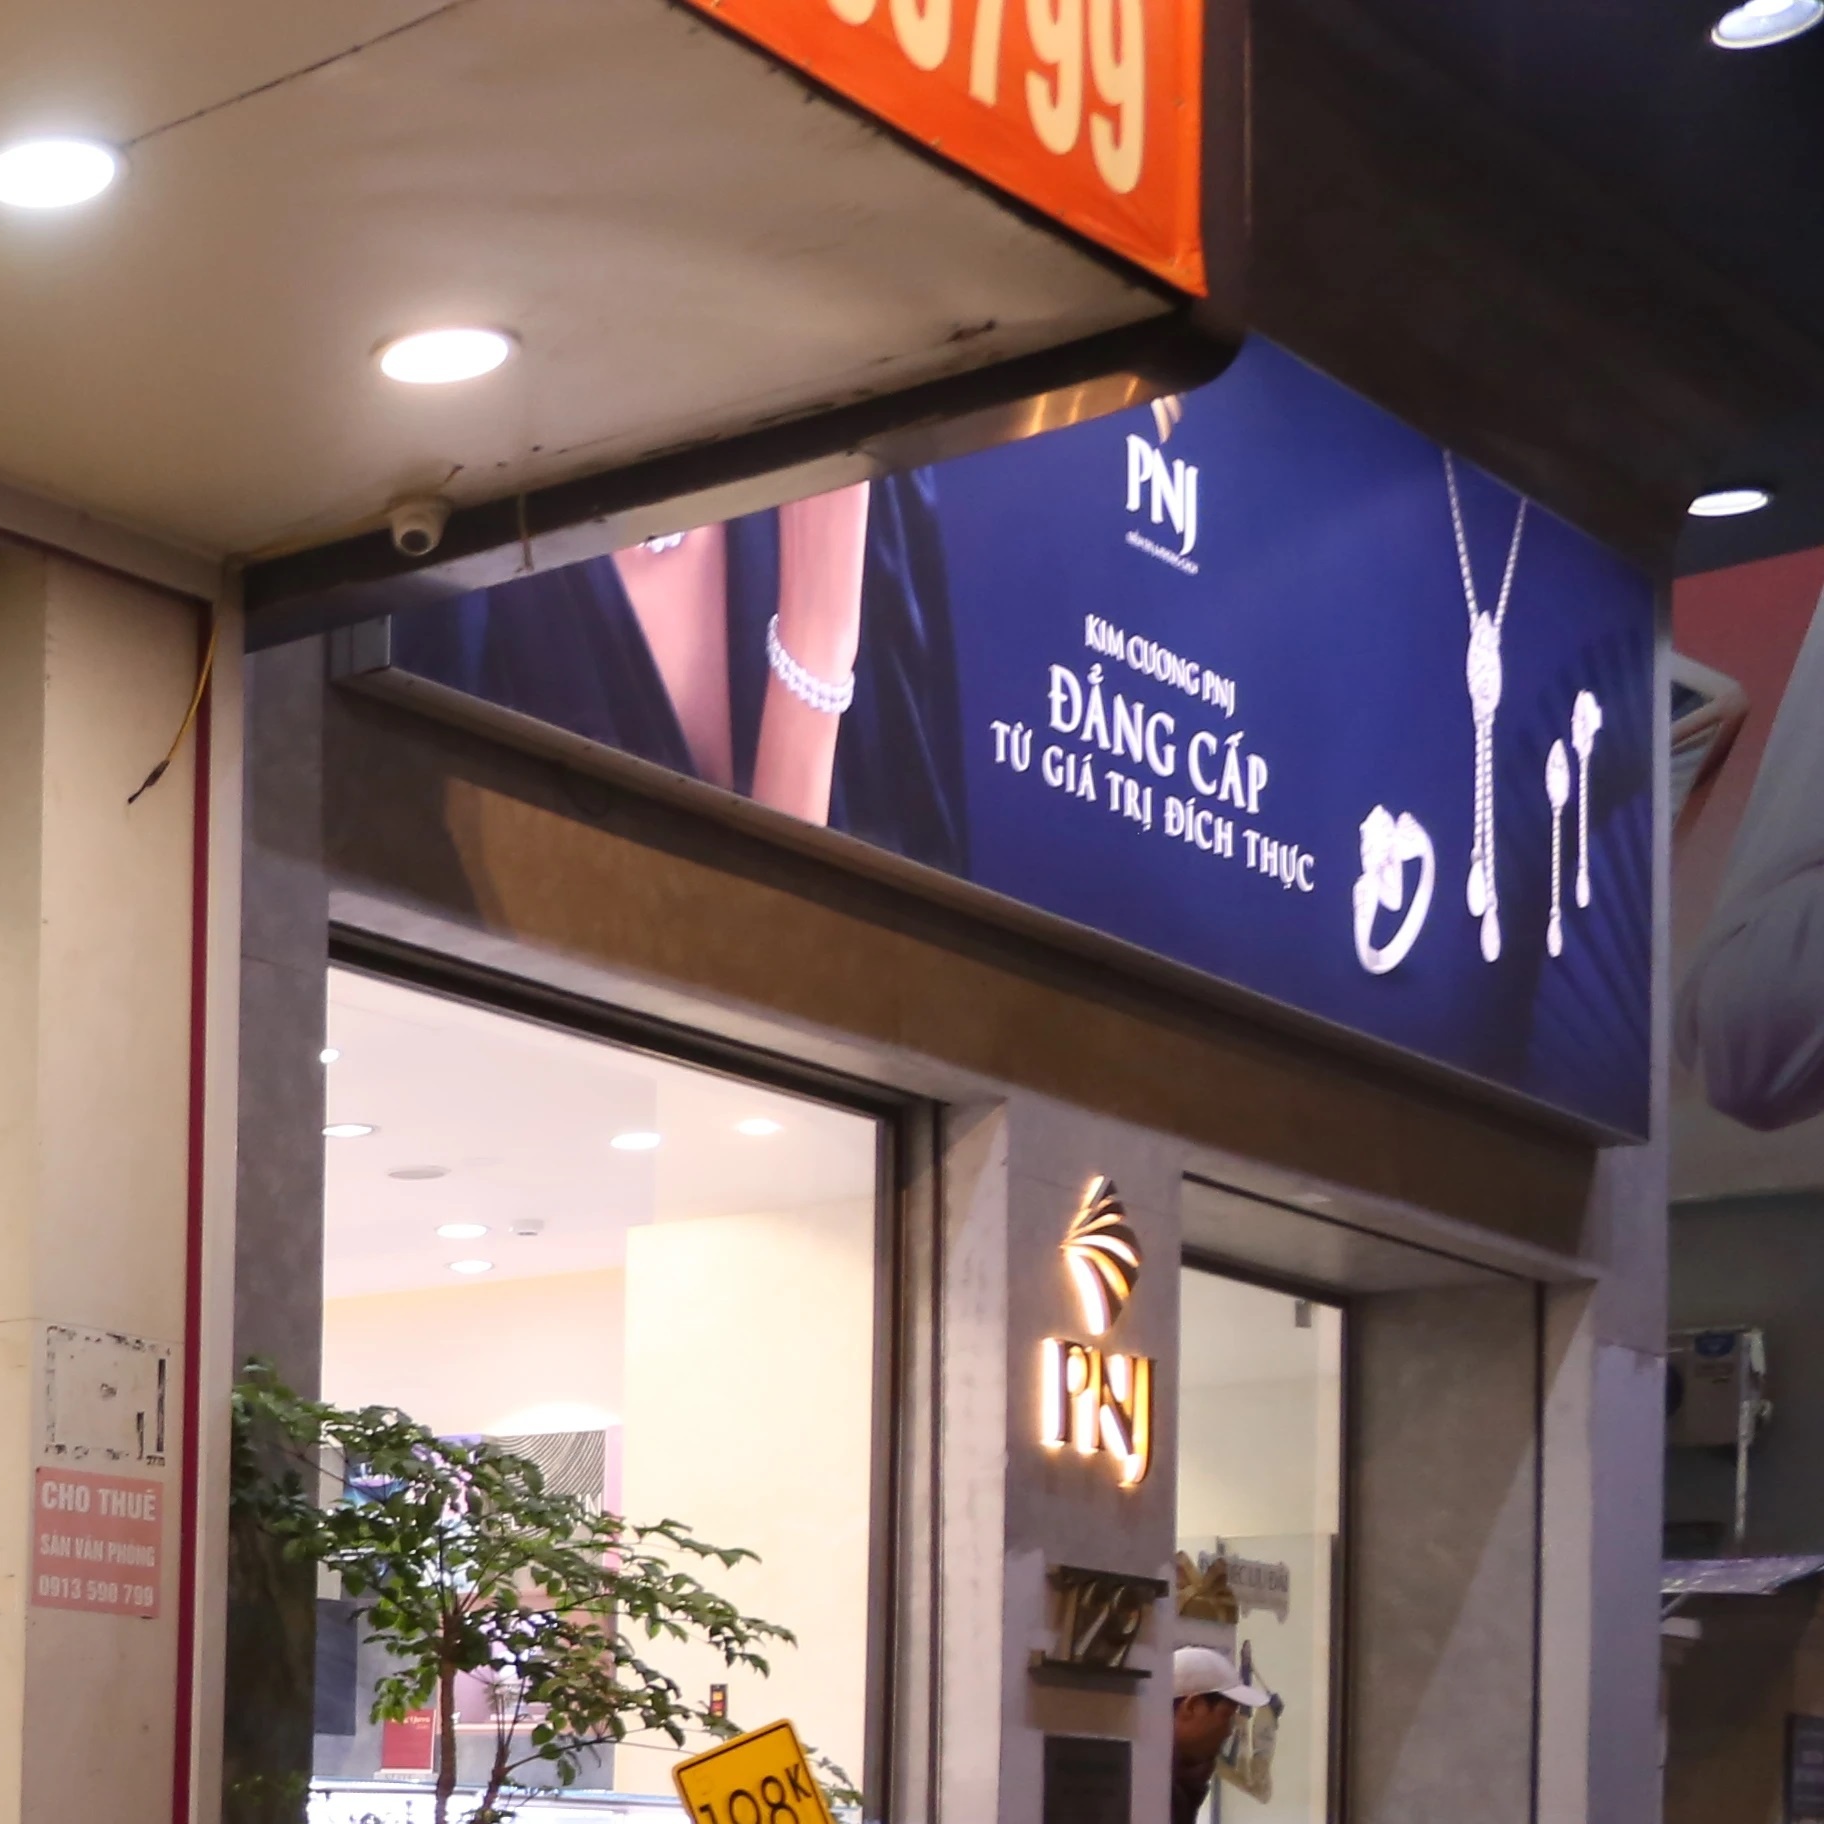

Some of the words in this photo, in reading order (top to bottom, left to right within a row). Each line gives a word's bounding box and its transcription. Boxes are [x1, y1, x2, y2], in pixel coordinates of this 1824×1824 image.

[1125, 433, 1199, 557] PNJ
[1084, 613, 1125, 661] KIM
[1201, 669, 1236, 719] PNJ
[1042, 745, 1097, 802] GIÁ
[1105, 770, 1152, 832] TRỊ
[1163, 795, 1235, 859] ĐÍCH
[1242, 828, 1315, 892] THỰC
[1188, 731, 1269, 814] CẤP
[1043, 1337, 1156, 1487] PNJ
[41, 1481, 90, 1513] CHO
